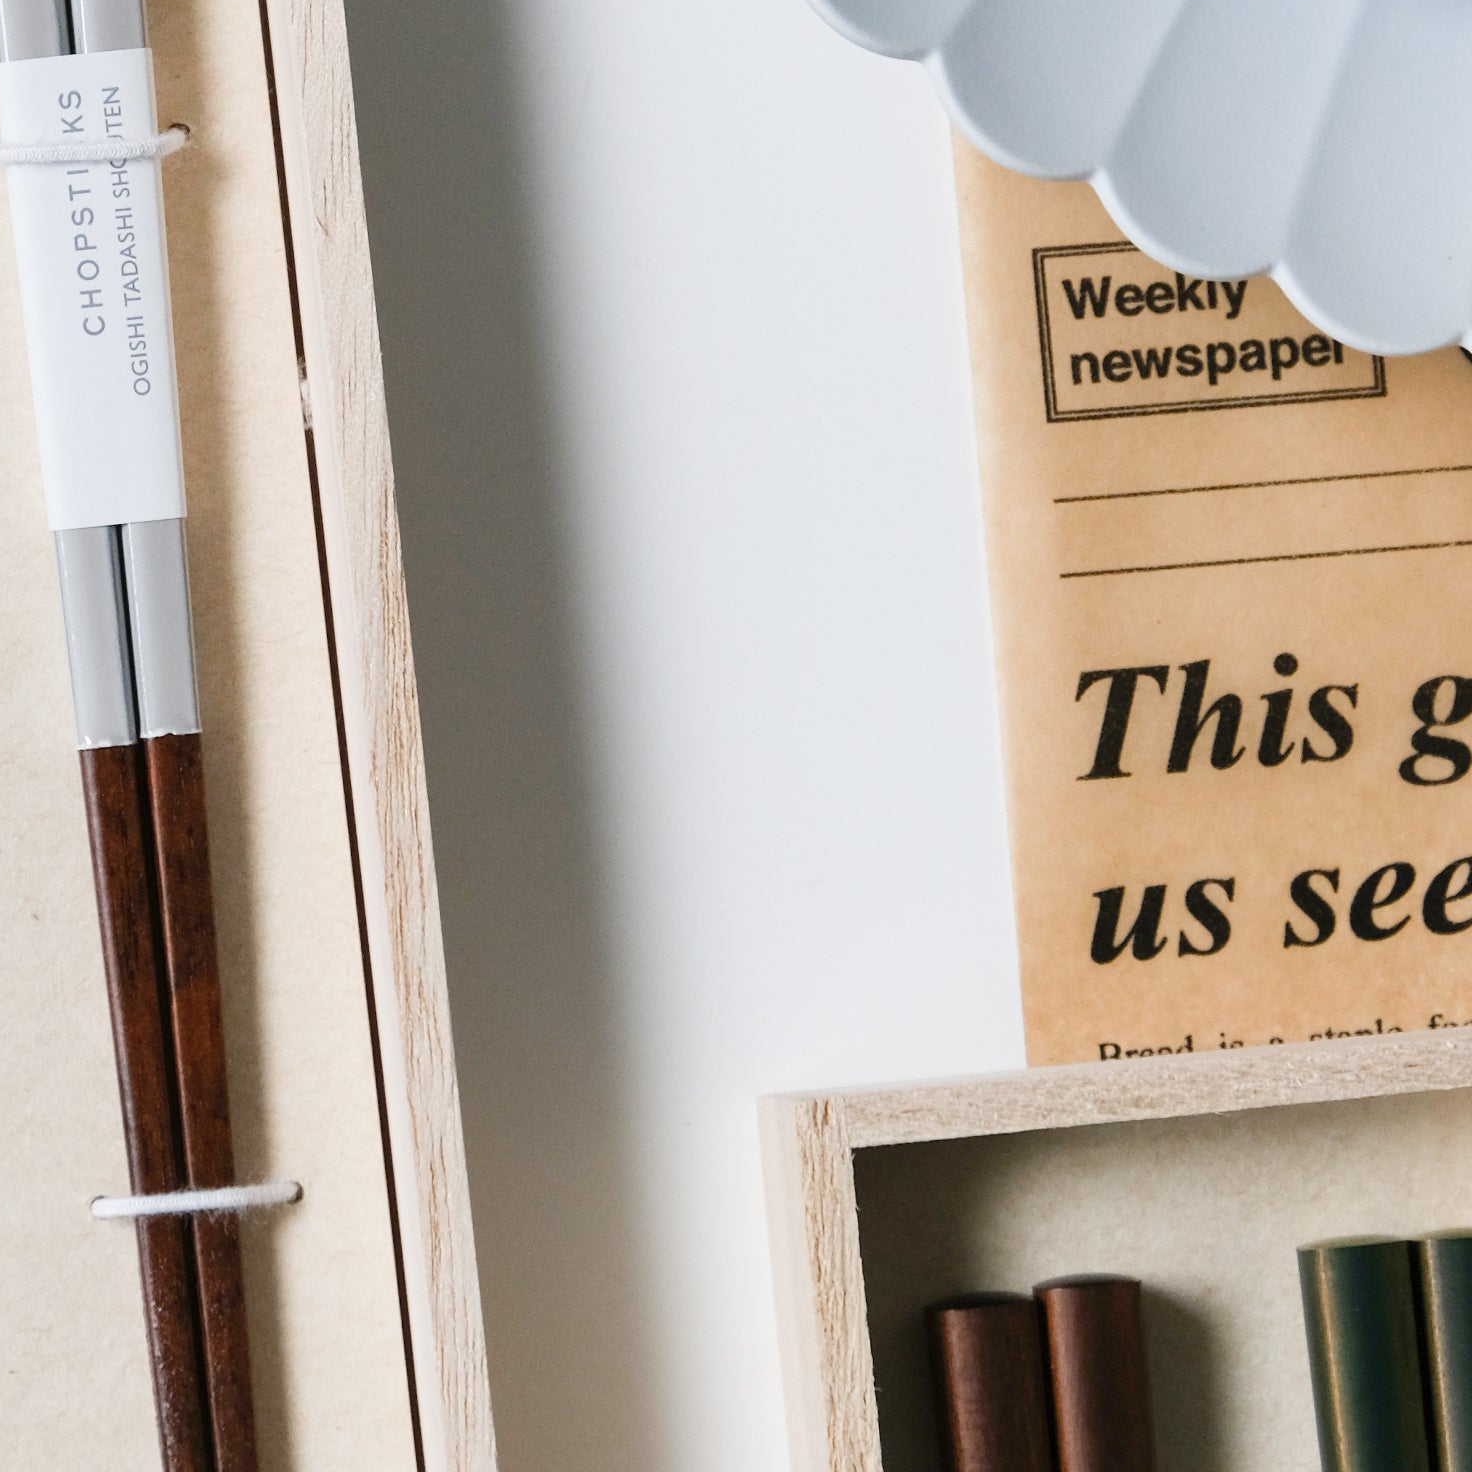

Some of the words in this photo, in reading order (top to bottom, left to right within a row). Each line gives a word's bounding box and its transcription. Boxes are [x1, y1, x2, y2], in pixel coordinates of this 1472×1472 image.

[58, 89, 105, 335] CHOPSTIKS
[115, 207, 141, 307] TADASHI
[1061, 271, 1248, 320] Weekly
[126, 315, 151, 396] OGISHI
[1074, 652, 1359, 781] This
[1090, 877, 1235, 965] us
[1283, 855, 1472, 949] see
